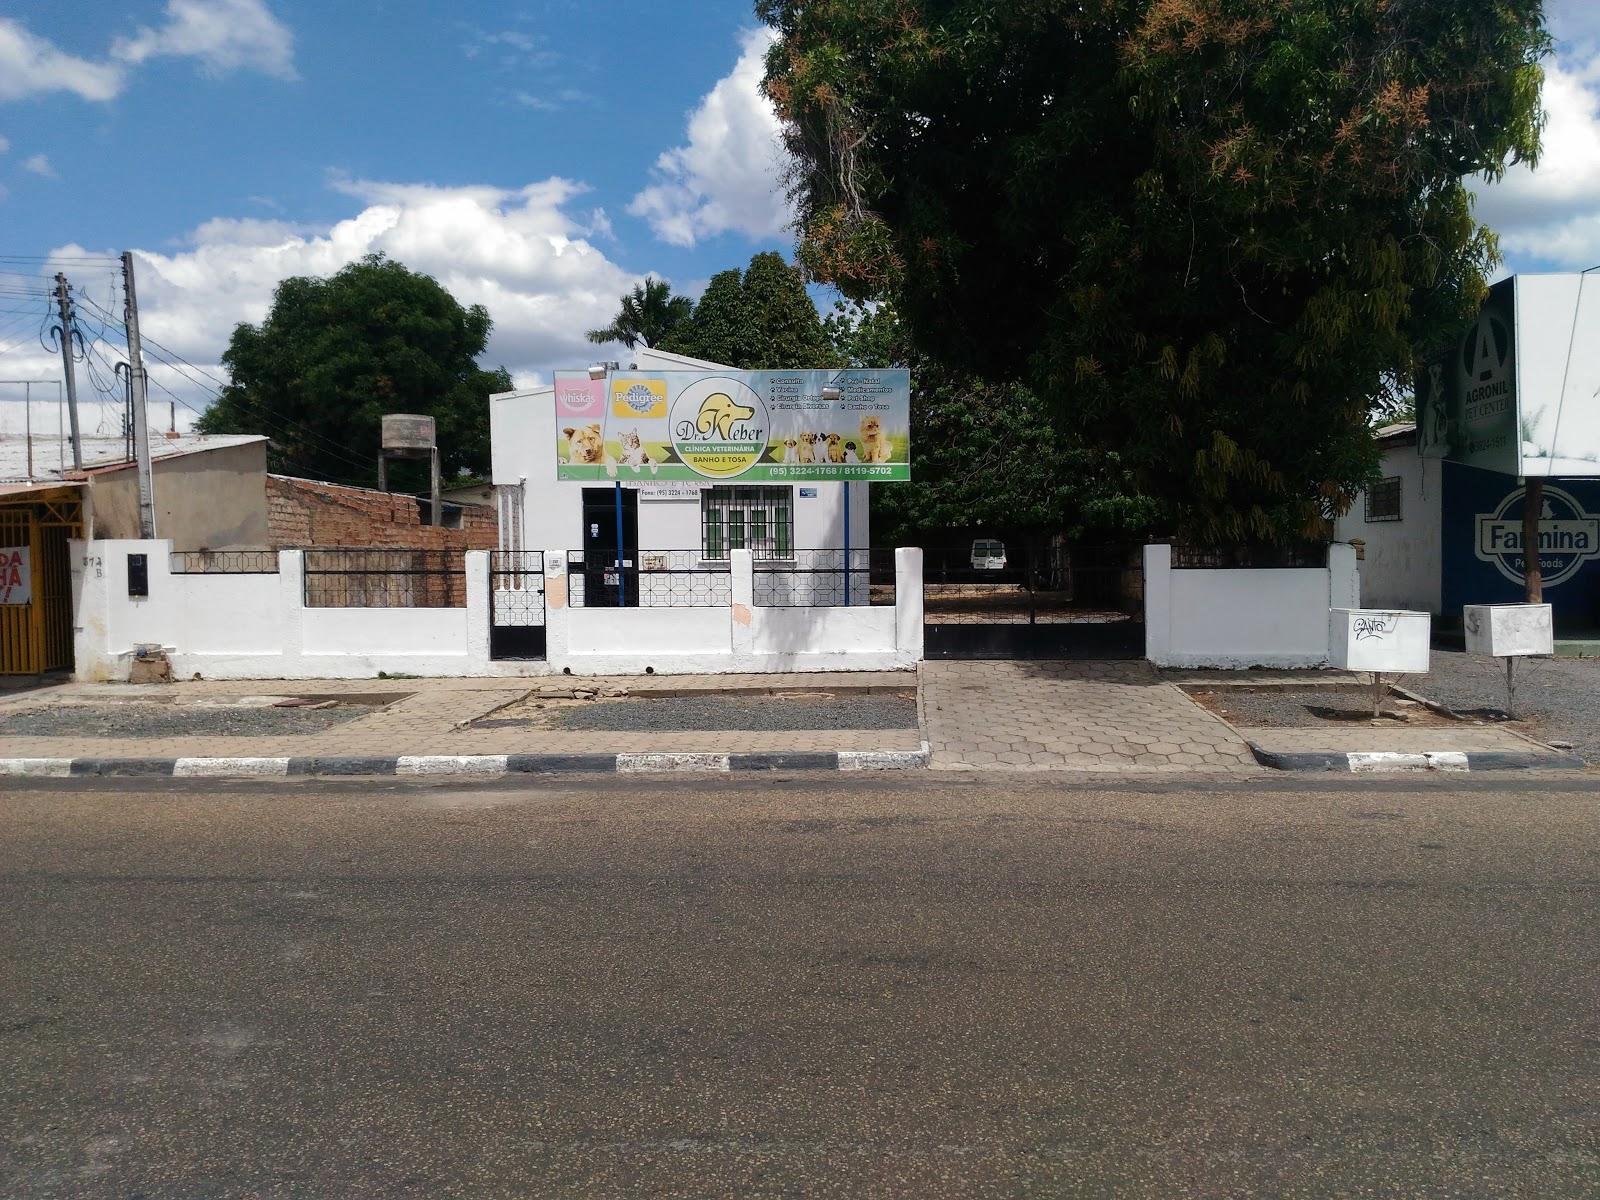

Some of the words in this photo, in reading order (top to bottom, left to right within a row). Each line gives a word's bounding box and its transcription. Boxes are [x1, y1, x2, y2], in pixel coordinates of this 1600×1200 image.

[615, 392, 663, 405] Pedigree
[1465, 381, 1509, 404] AGRONIL
[676, 420, 700, 441] Dr.
[696, 409, 762, 441] Kleber
[685, 445, 711, 453] CLÍNICA
[712, 445, 755, 453] VETERINÁRIA
[769, 467, 787, 476] (95)
[790, 467, 837, 475] 3224-1768
[844, 467, 892, 475] 8119-5702
